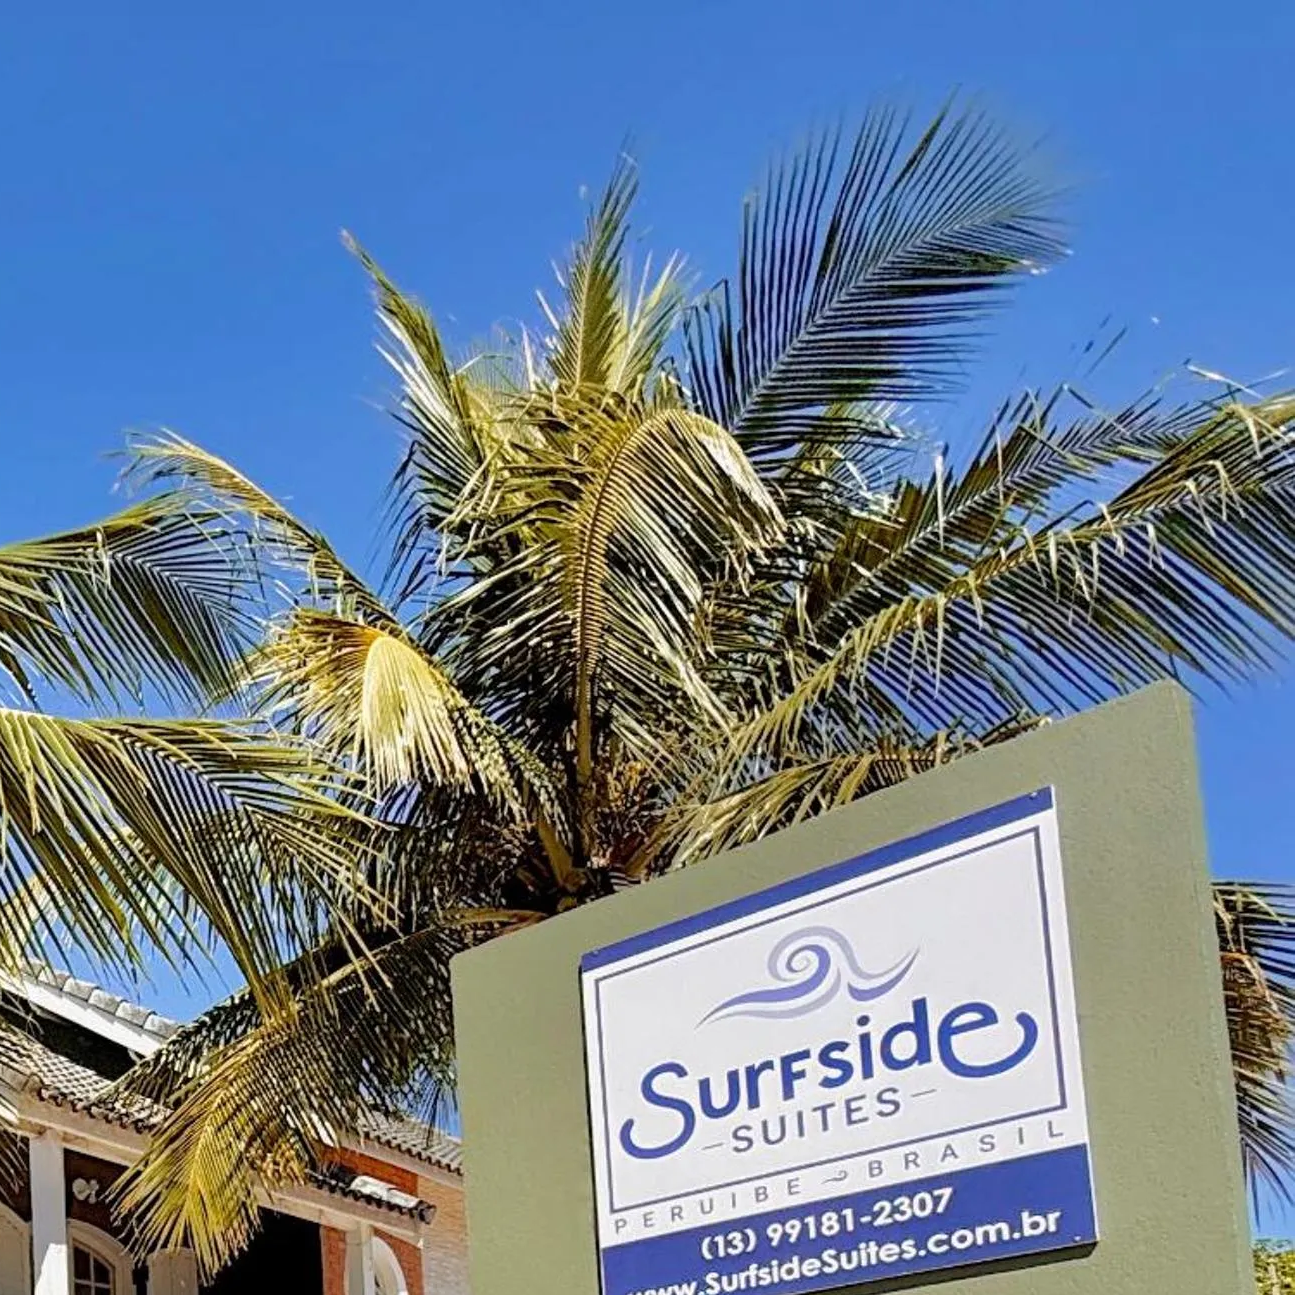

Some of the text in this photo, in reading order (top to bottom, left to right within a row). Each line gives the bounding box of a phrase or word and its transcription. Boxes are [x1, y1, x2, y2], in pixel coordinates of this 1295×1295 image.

[731, 1086, 901, 1154] SUITES
[614, 1119, 1065, 1233] PERUIBE BRASIL
[700, 1187, 955, 1261] (13) 99181-2307
